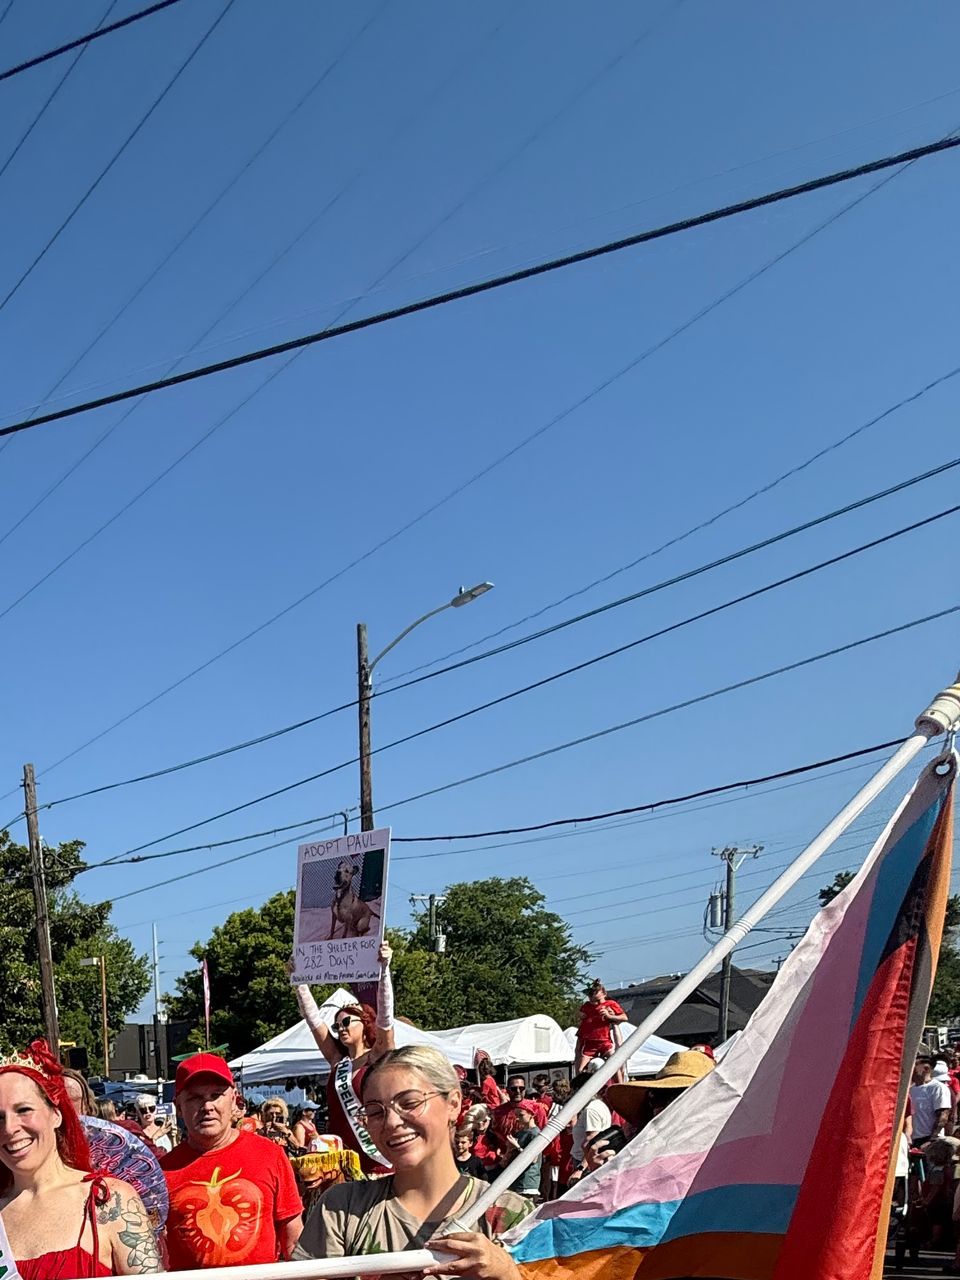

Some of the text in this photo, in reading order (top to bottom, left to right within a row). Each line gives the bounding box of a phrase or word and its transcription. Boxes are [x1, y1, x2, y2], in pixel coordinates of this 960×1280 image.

[304, 834, 376, 859] ADOPT PAUL
[296, 939, 376, 957] IN THE SHELTER FOR
[304, 955, 323, 970] 282
[337, 1060, 358, 1117] HAPPELL
